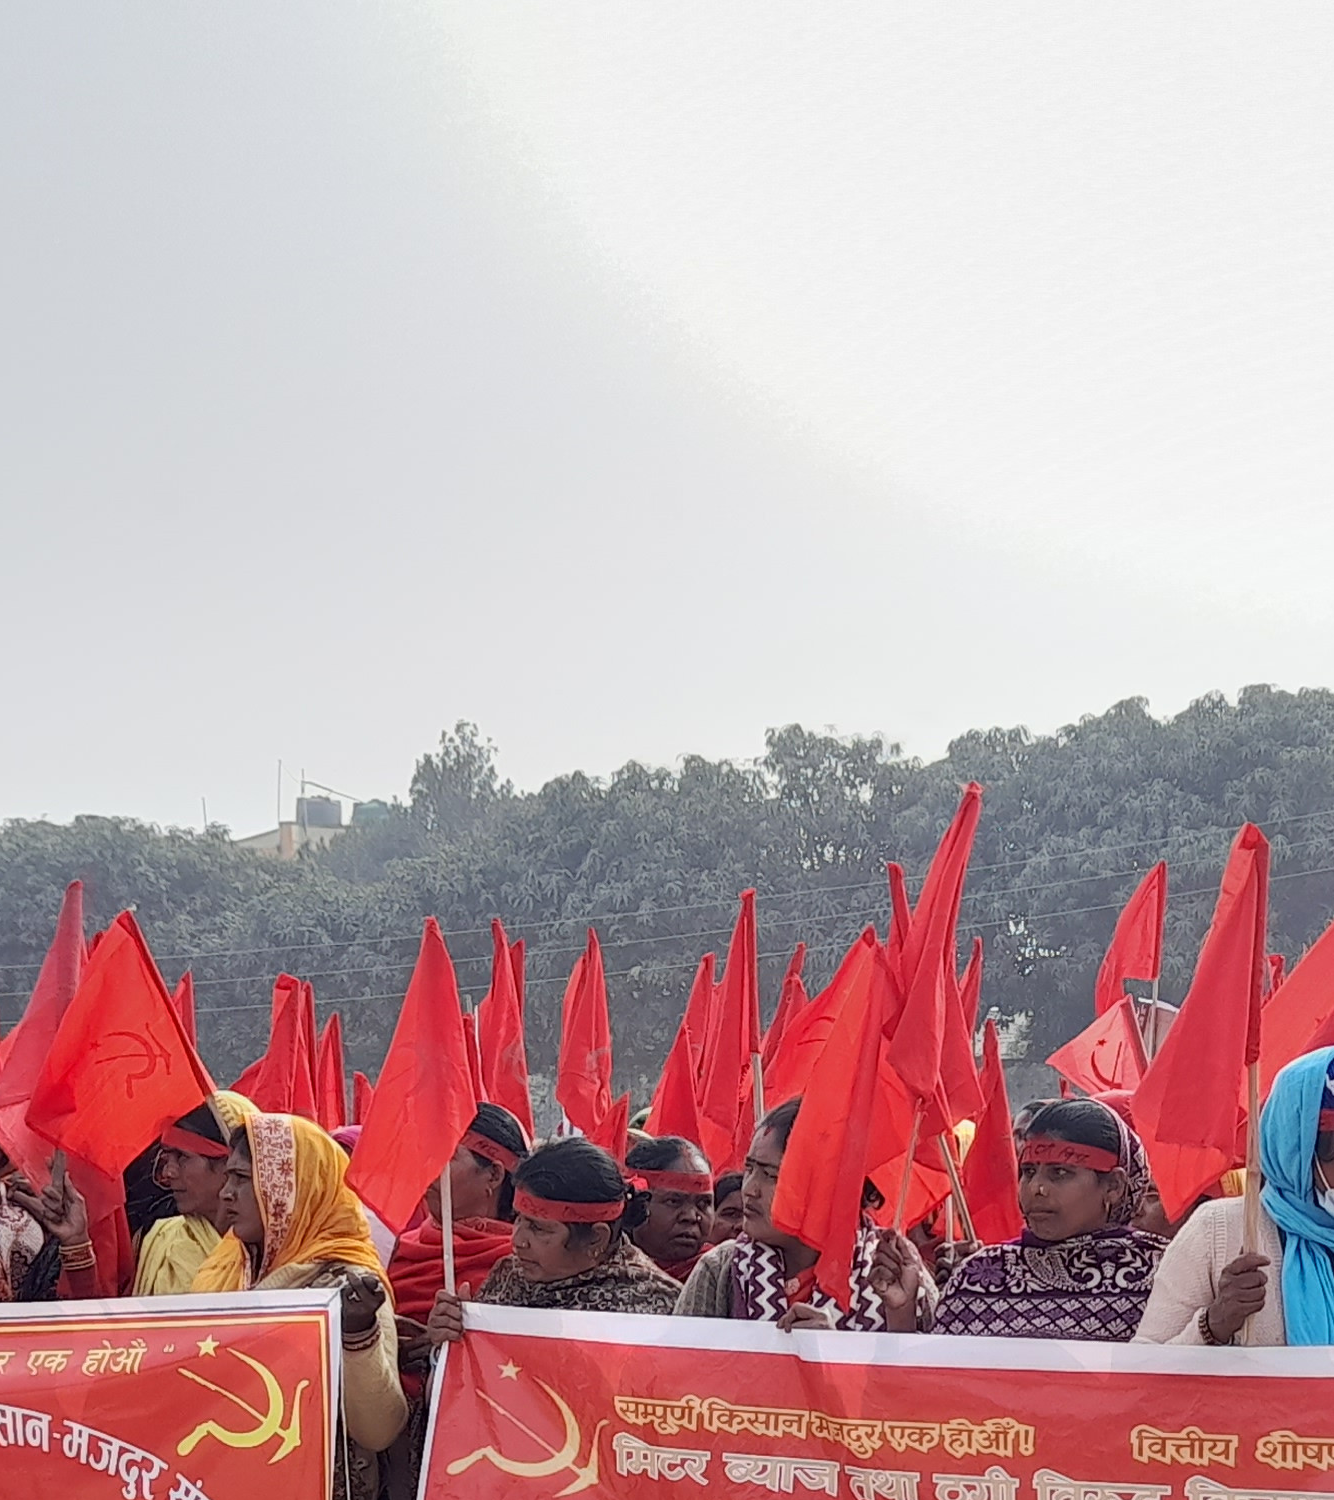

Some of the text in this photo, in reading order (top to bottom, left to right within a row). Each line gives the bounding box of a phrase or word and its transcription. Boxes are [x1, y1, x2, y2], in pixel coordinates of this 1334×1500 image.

[26, 1350, 74, 1376] एक
[614, 1396, 700, 1433] सम्पूर्ण
[703, 1398, 808, 1438] किसान
[884, 1422, 939, 1452] एक
[1131, 1425, 1238, 1466] वित्तीय
[612, 1431, 711, 1486] मिटर
[722, 1452, 840, 1497] ब्याज
